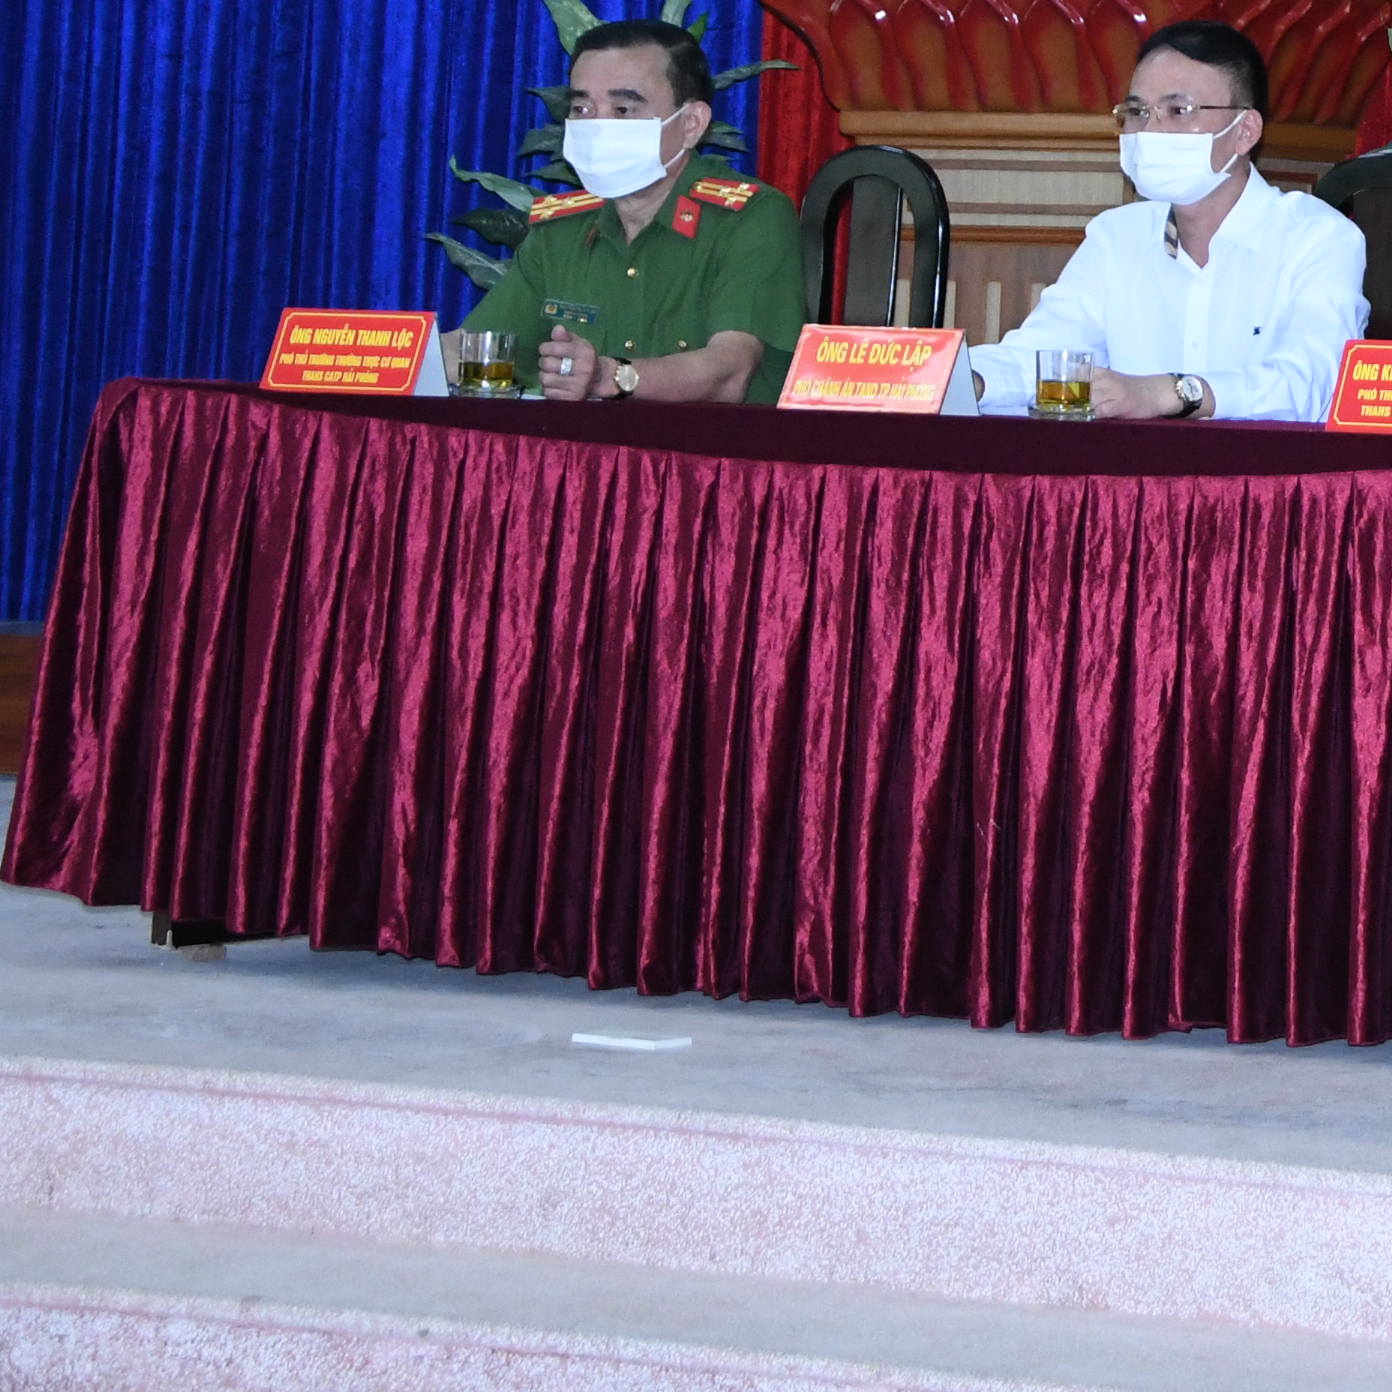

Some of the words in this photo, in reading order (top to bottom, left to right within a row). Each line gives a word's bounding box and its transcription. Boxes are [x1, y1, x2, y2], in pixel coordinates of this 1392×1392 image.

[291, 325, 313, 345] ÔNG
[392, 328, 414, 351] LỘC
[817, 336, 849, 363] ÔNG
[849, 338, 869, 364] LÊ
[869, 338, 902, 365] ĐỨC
[902, 340, 933, 373] LẬP
[1353, 360, 1380, 381] ÔNG
